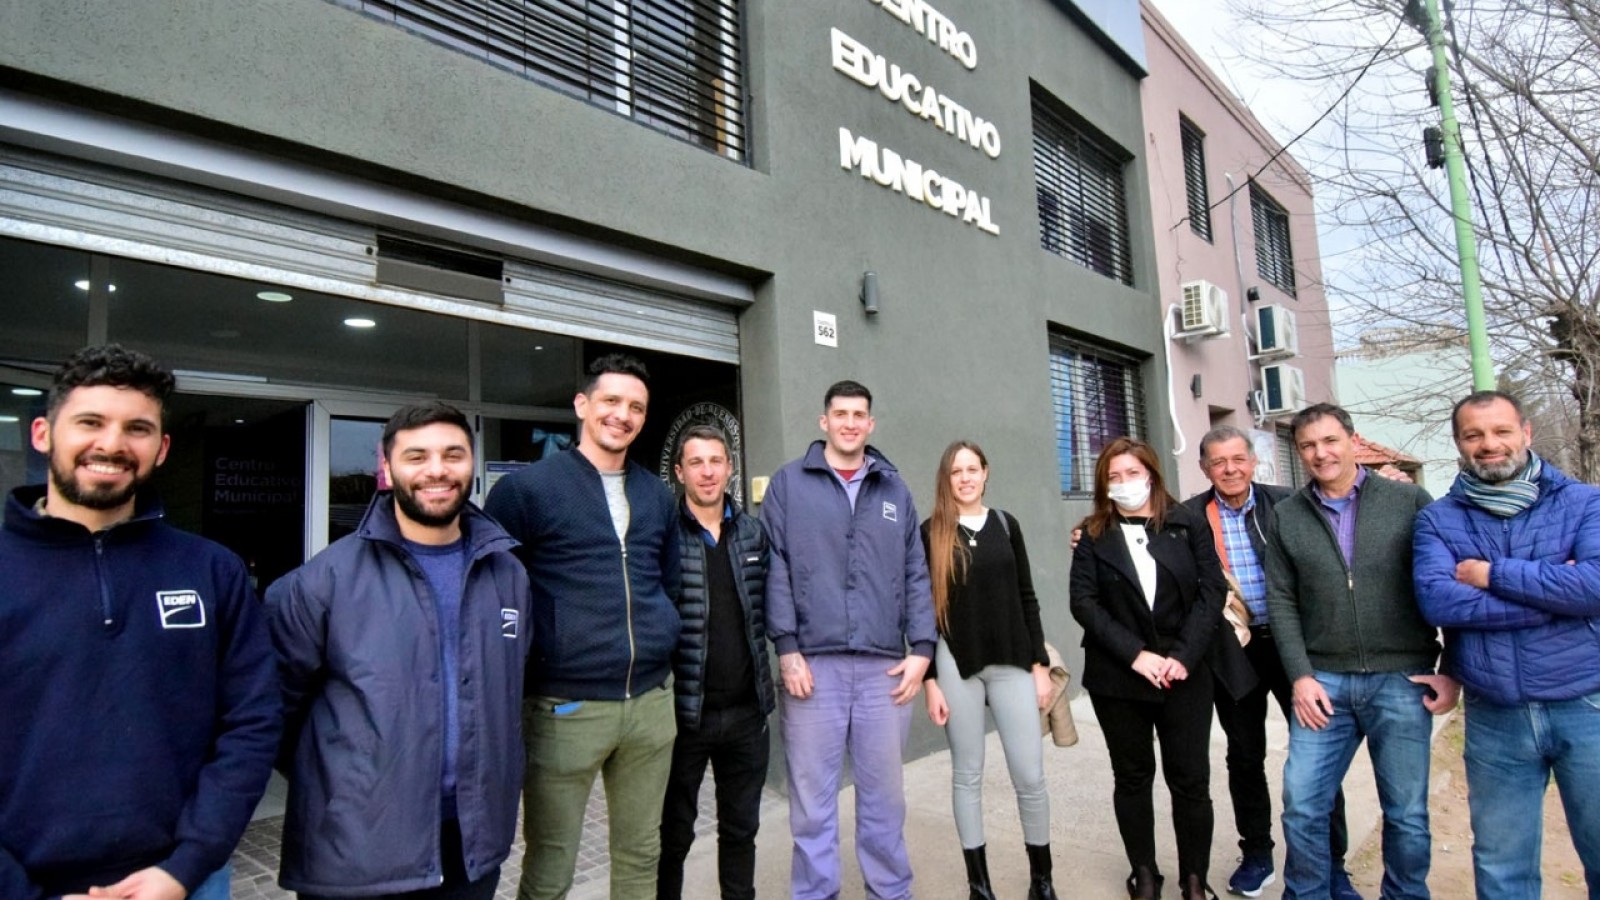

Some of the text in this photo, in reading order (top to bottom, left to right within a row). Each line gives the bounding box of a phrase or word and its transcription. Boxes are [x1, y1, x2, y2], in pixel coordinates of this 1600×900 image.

[868, 0, 977, 69] NTRO
[831, 27, 1001, 159] EDUCATIVO
[839, 126, 1001, 235] MUNICIPAL
[818, 325, 835, 338] 562
[215, 457, 275, 471] Centro
[215, 473, 301, 487] Educativo
[214, 489, 297, 504] Municipal
[163, 594, 196, 606] EDEN
